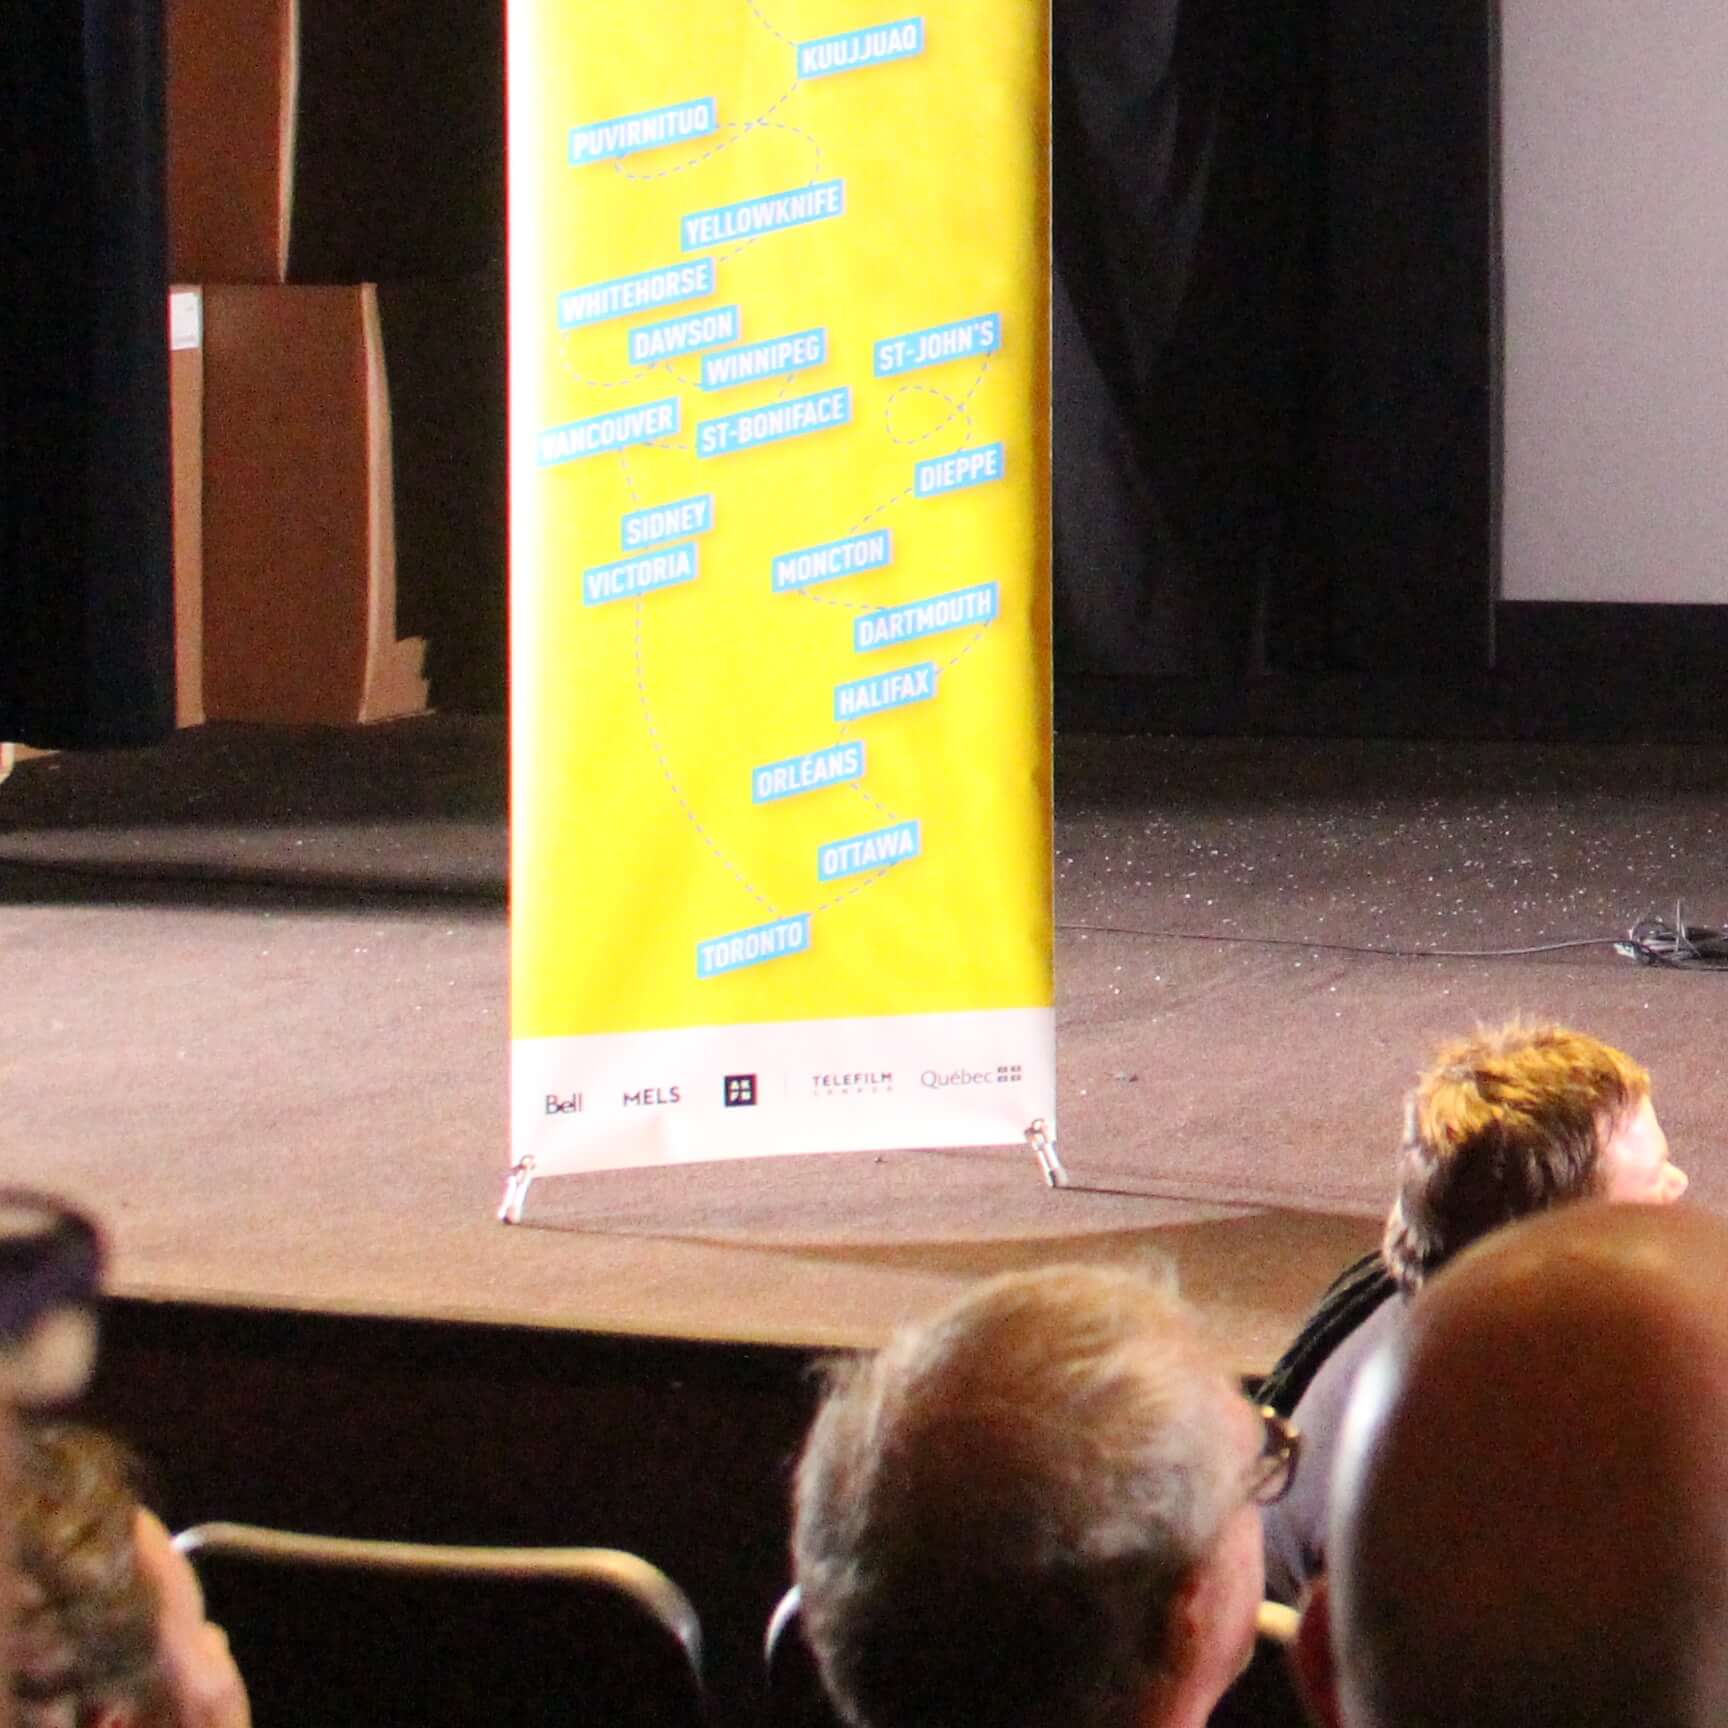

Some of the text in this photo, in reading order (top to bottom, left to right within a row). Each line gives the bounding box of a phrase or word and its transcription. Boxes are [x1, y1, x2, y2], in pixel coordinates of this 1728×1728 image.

[801, 23, 918, 73] KUUJJUAQ
[572, 103, 710, 161] PUVIRNITUQ
[685, 185, 840, 246] YELLOWKNIFE
[560, 264, 709, 324] WHITEHORSE
[633, 310, 734, 360] DAWSON
[705, 334, 820, 385] WINNIPEG
[878, 320, 995, 372] ST-JOHN'S
[541, 403, 674, 462] VANCOUVER
[701, 393, 845, 453] ST-BONIFACE
[919, 447, 998, 493] DIEPPE
[626, 500, 709, 546] SIDNEY
[587, 551, 692, 601] VICTORIA
[776, 536, 885, 587] MONCTON
[858, 588, 993, 648] DARTMOUTH
[838, 667, 930, 718] HALIFAX
[756, 745, 859, 799] ORLÉANS
[822, 826, 913, 876] OTTAWA
[701, 919, 804, 972] TORONTO
[545, 1092, 583, 1115] Bell
[623, 1085, 682, 1108] MELS
[812, 1072, 893, 1088] TELEFILM
[920, 1067, 994, 1092] Québec
